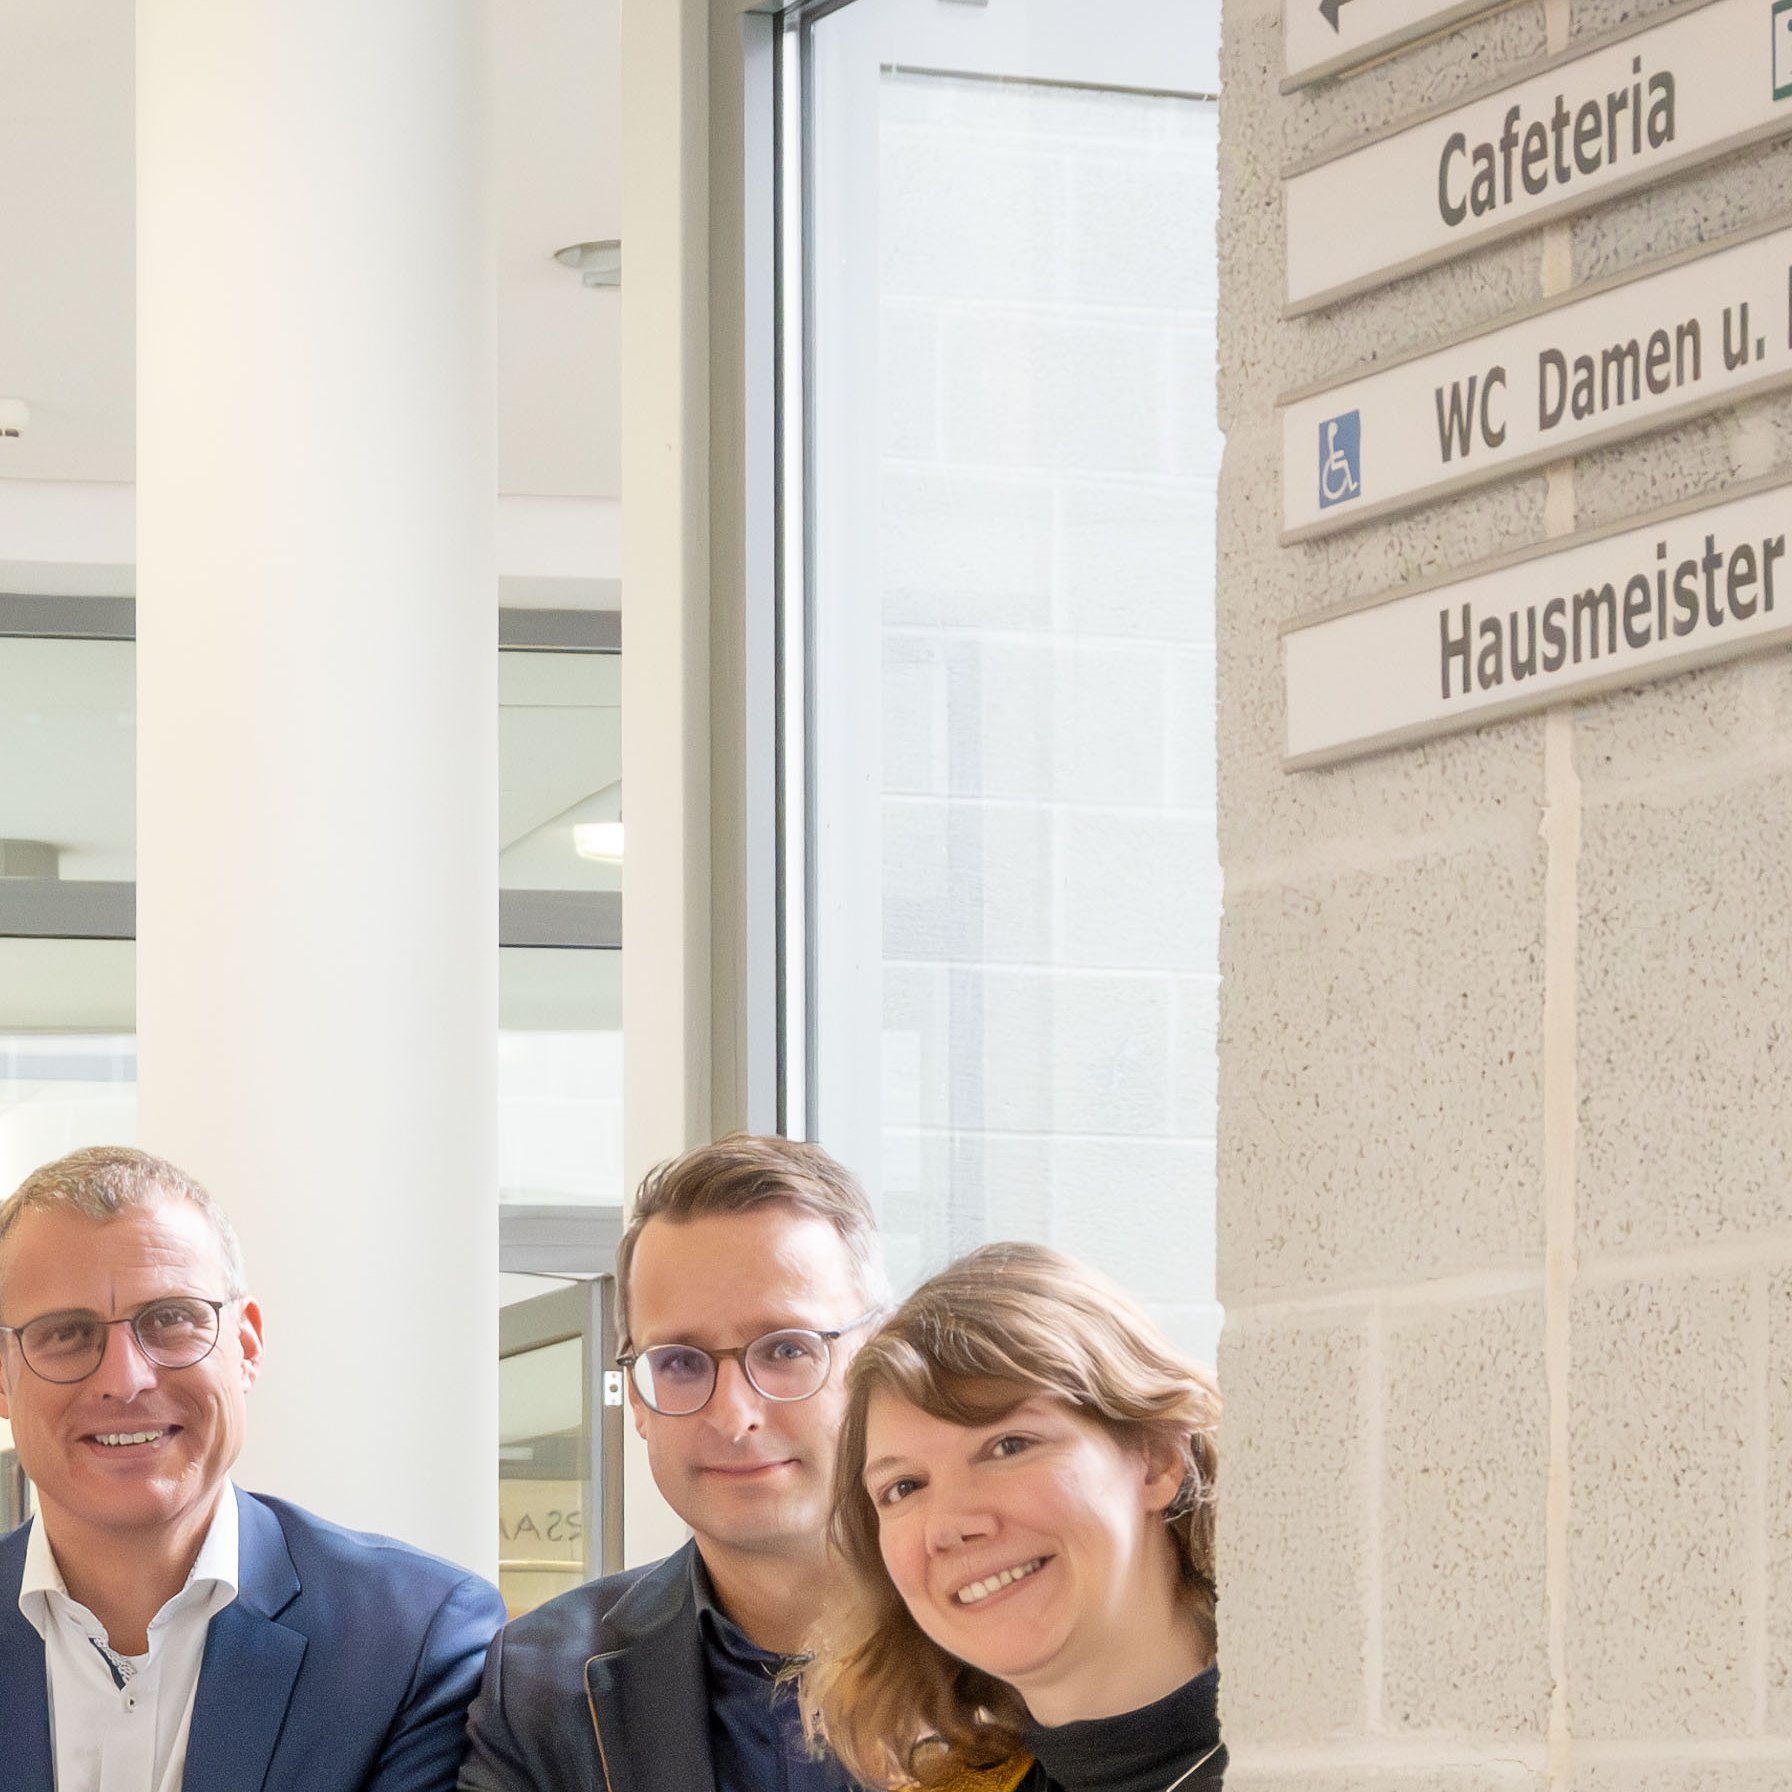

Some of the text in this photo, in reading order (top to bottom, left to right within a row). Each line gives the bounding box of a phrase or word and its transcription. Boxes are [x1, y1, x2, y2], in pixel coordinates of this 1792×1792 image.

[1436, 56, 1676, 227] Cafeteria
[1435, 366, 1506, 463] WC
[1539, 319, 1700, 431] Damen
[1722, 302, 1764, 370] u.
[1439, 534, 1785, 699] Hausmeister
